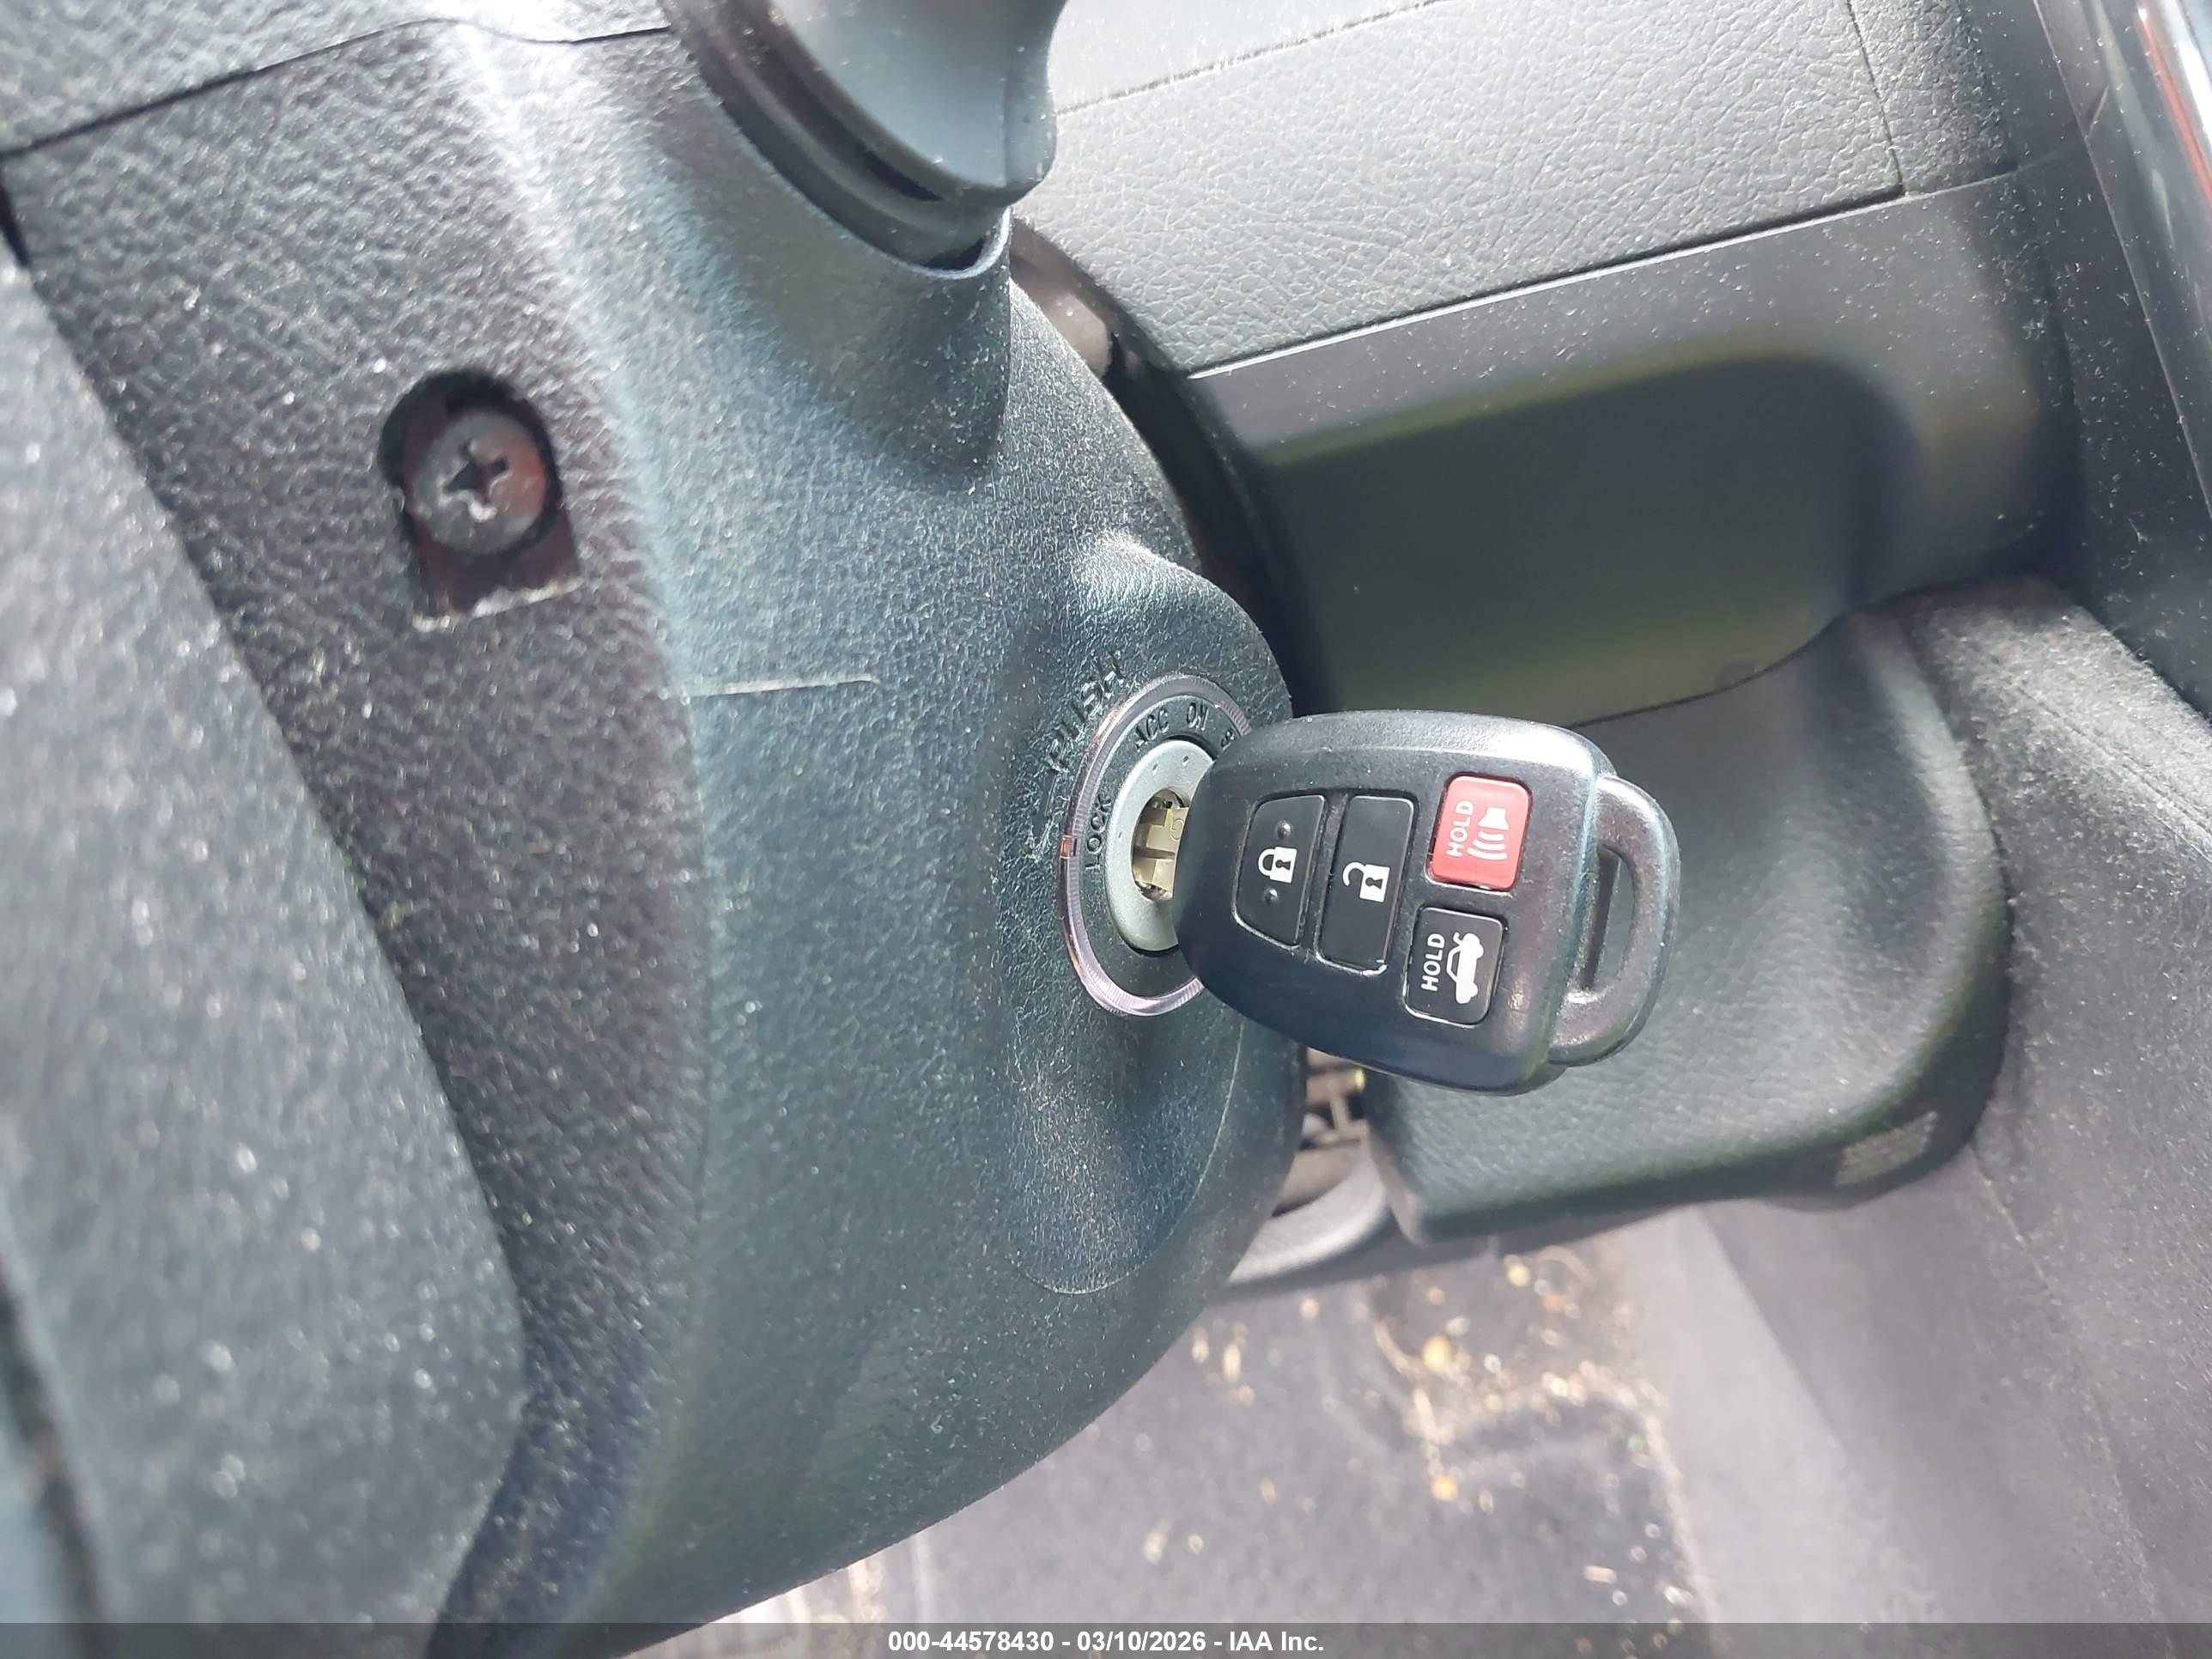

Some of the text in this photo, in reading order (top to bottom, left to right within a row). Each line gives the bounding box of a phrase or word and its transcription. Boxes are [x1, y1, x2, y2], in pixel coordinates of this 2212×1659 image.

[1135, 706, 1169, 752] ACC
[1186, 702, 1210, 731] ON
[1085, 792, 1113, 871] LOCK
[1446, 800, 1474, 857] HOLD
[1421, 933, 1445, 992] HOLD
